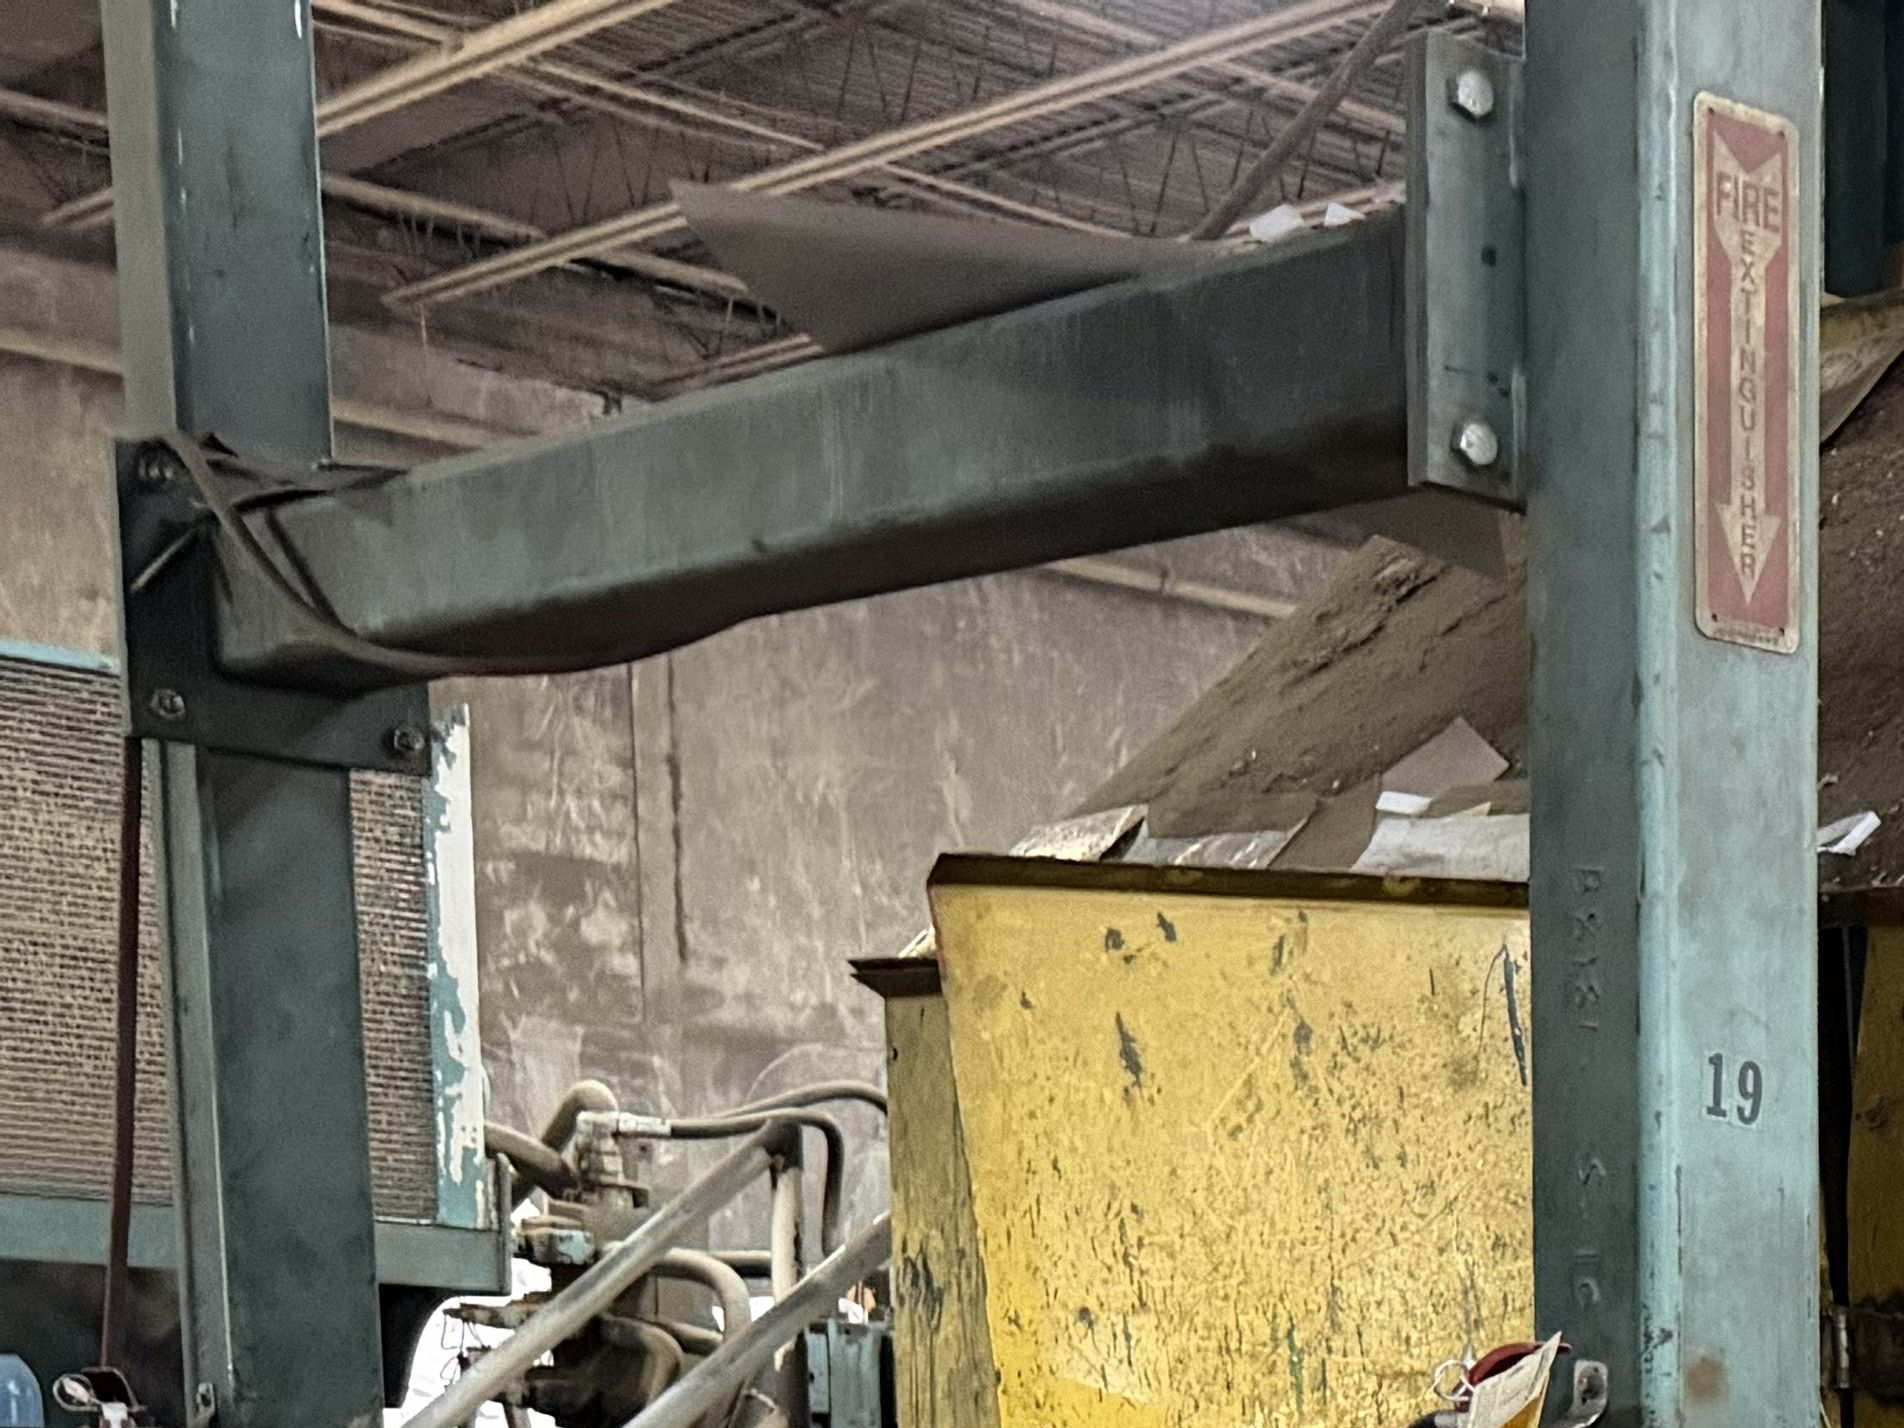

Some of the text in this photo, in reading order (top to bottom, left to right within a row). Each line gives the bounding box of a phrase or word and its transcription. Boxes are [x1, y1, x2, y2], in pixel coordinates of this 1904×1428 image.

[1716, 171, 1780, 233] FIRE
[1739, 229, 1757, 581] EXTINGUISHER
[1706, 1052, 1764, 1126] 19
